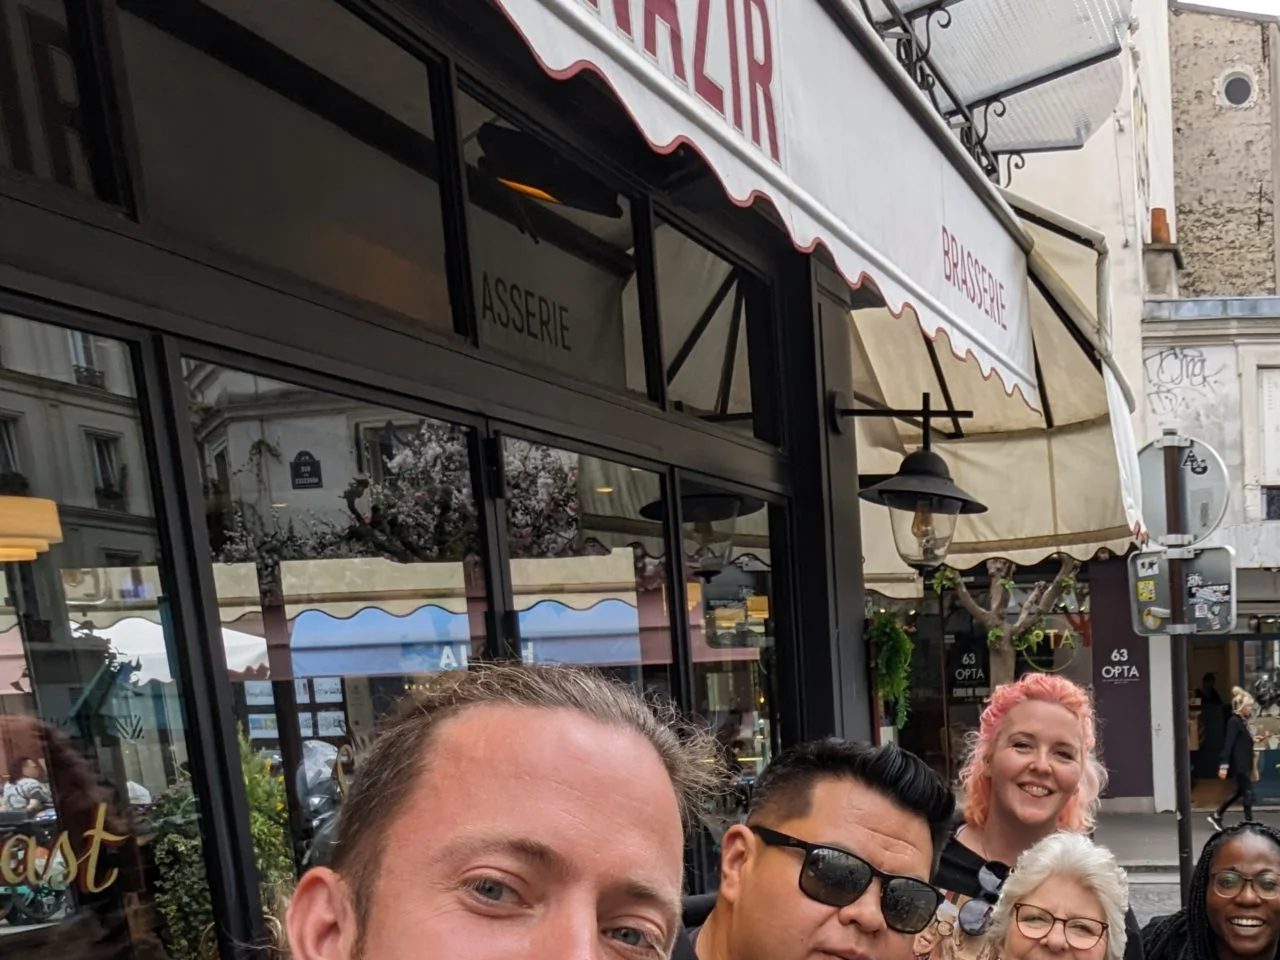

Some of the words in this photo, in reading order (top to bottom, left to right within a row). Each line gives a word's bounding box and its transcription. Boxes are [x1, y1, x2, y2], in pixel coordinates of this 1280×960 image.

[582, 0, 781, 168] AZIR
[942, 225, 1007, 331] BRASSERIE
[482, 271, 571, 351] ASSERIE
[1015, 629, 1075, 651] PTA
[962, 653, 976, 664] 63
[1111, 648, 1129, 661] 63
[955, 668, 985, 680] OPTA
[1102, 665, 1140, 678] OPTA
